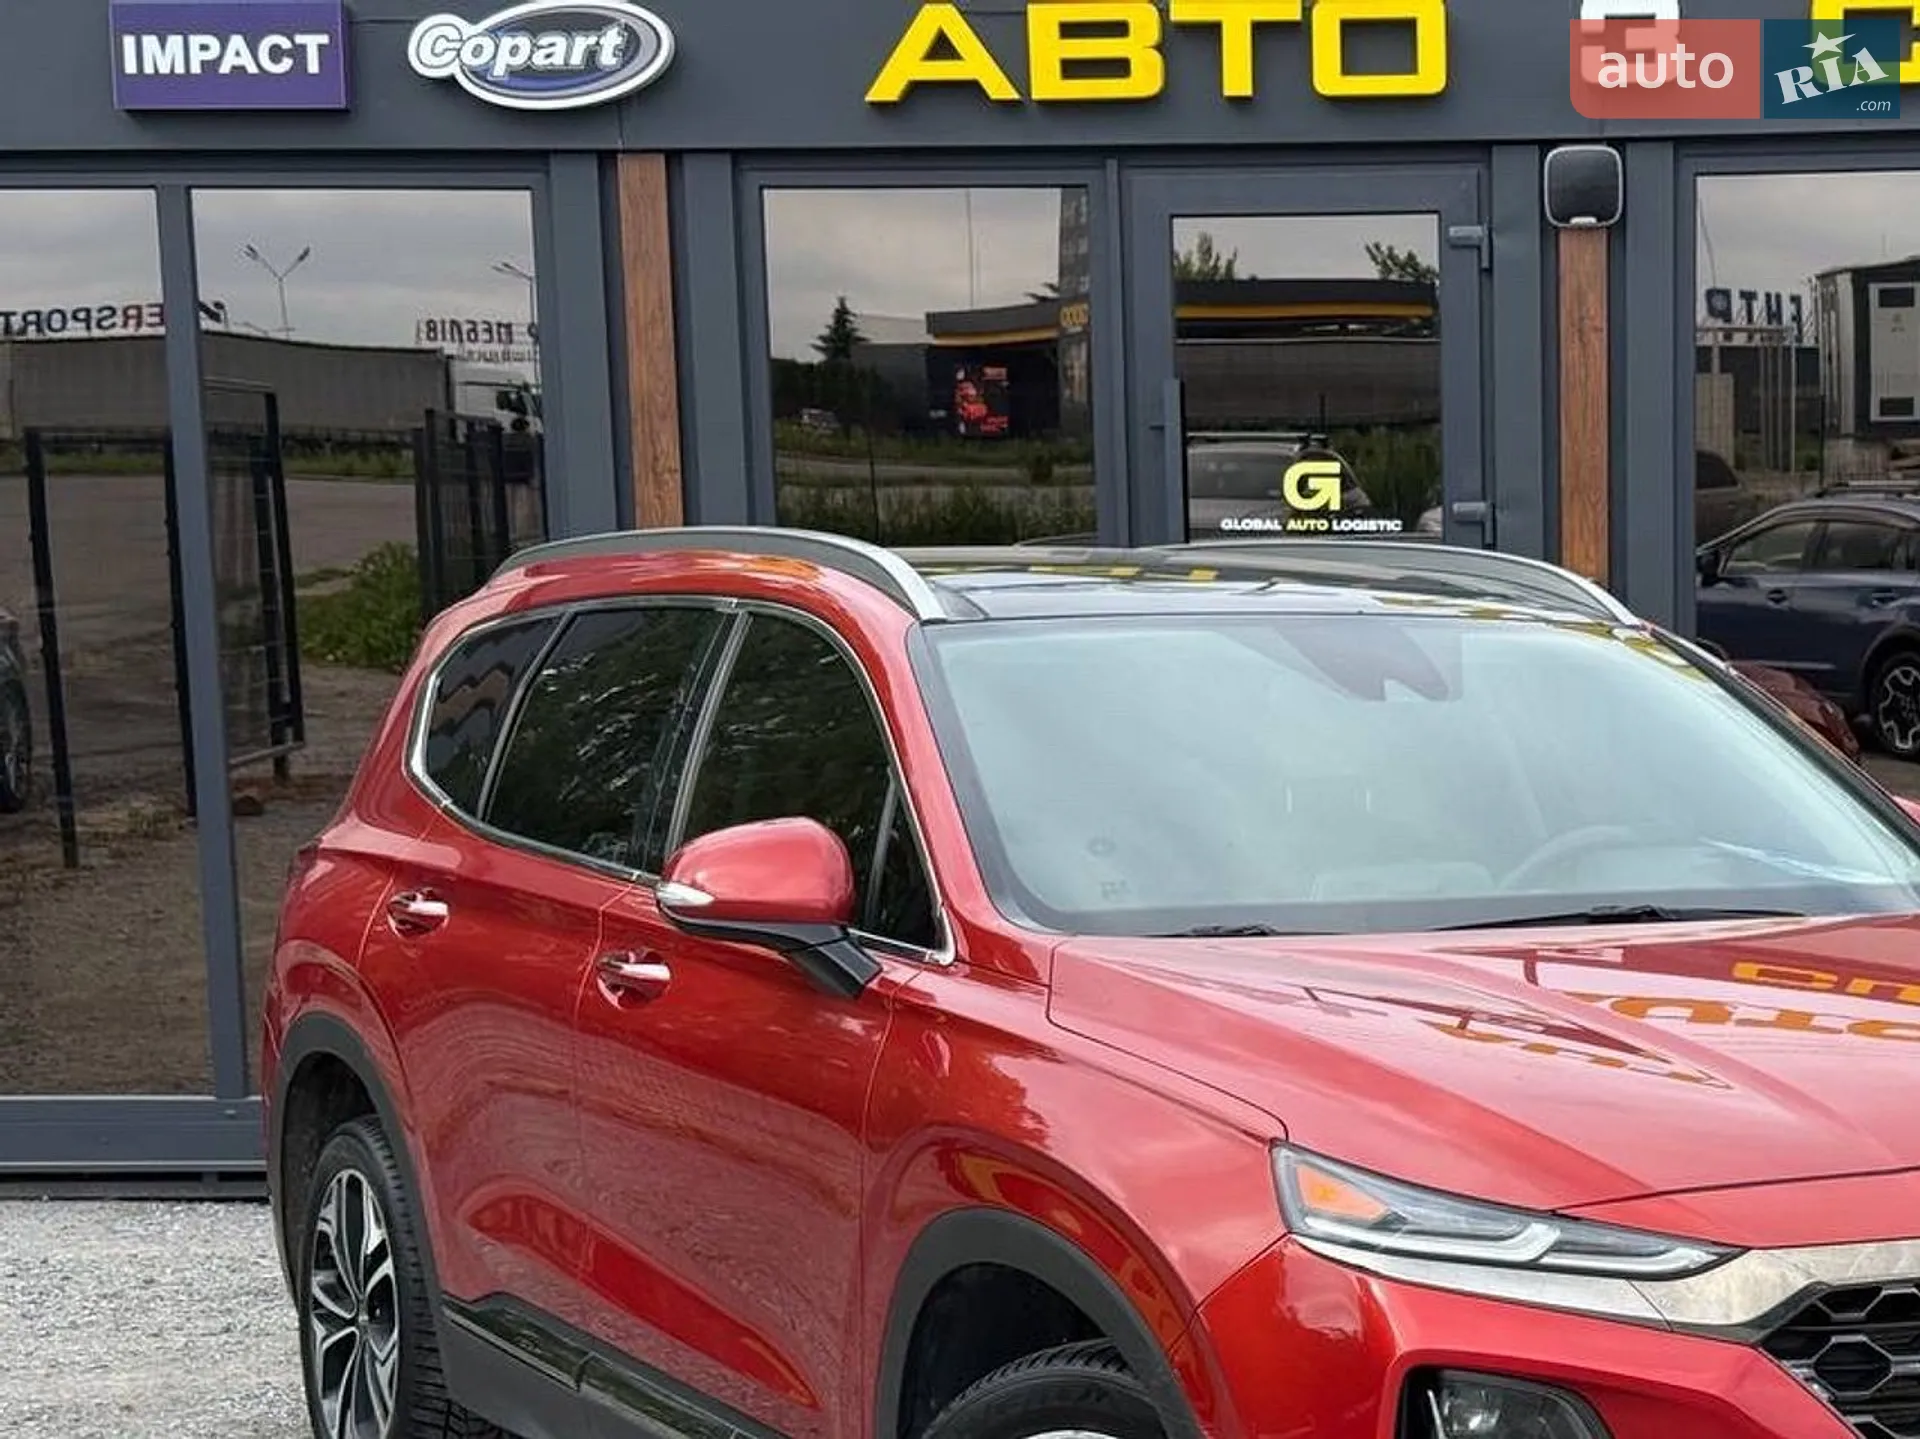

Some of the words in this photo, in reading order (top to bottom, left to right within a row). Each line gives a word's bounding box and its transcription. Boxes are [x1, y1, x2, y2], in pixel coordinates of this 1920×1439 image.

[122, 33, 330, 75] IMPACT
[418, 21, 631, 81] Copart
[865, 0, 1446, 101] АВТО
[1220, 518, 1283, 531] GLOBAL
[1286, 519, 1329, 531] AUTO
[1332, 519, 1403, 531] LOGISTIC
